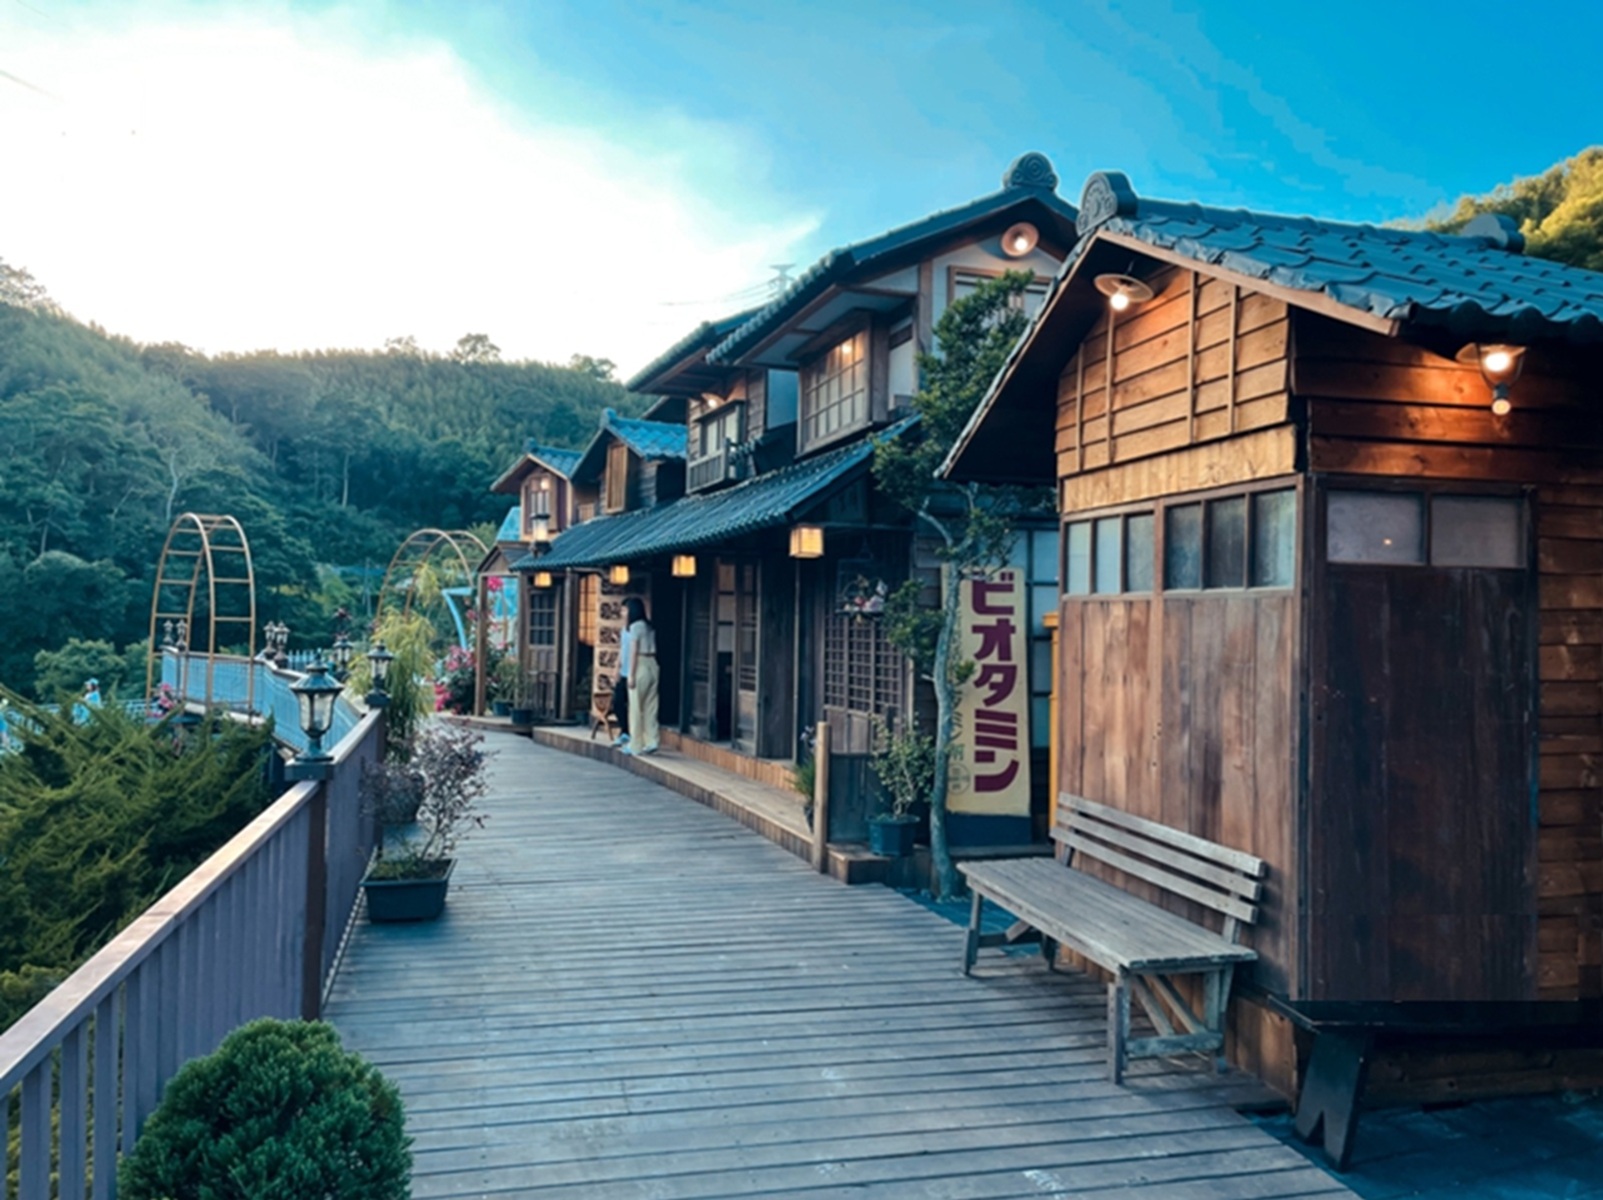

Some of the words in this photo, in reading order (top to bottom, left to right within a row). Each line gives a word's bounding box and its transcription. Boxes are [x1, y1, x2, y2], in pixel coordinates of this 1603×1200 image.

[971, 571, 1020, 793] ビオタミン
